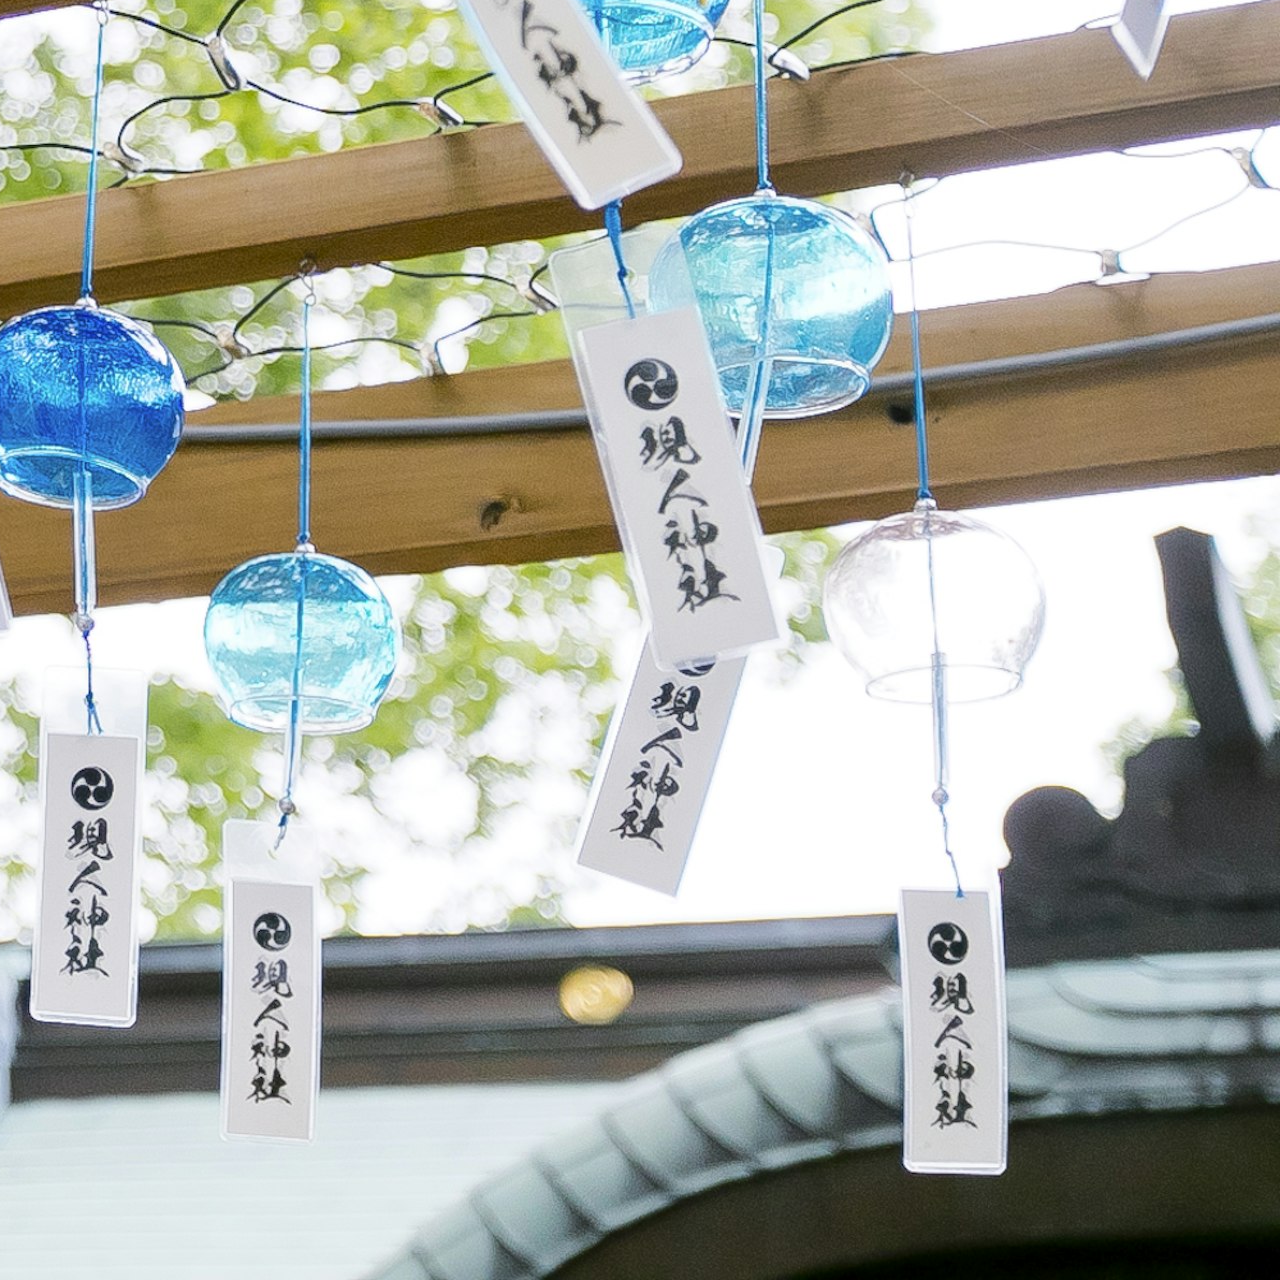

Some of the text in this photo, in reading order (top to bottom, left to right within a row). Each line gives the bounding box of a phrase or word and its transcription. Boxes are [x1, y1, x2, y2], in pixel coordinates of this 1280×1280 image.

[639, 417, 740, 613] 現人神社
[609, 682, 702, 851] 現人神社
[59, 820, 113, 978] 現人神社
[246, 958, 293, 1104] 現人神社
[928, 972, 978, 1130] 現人神社
